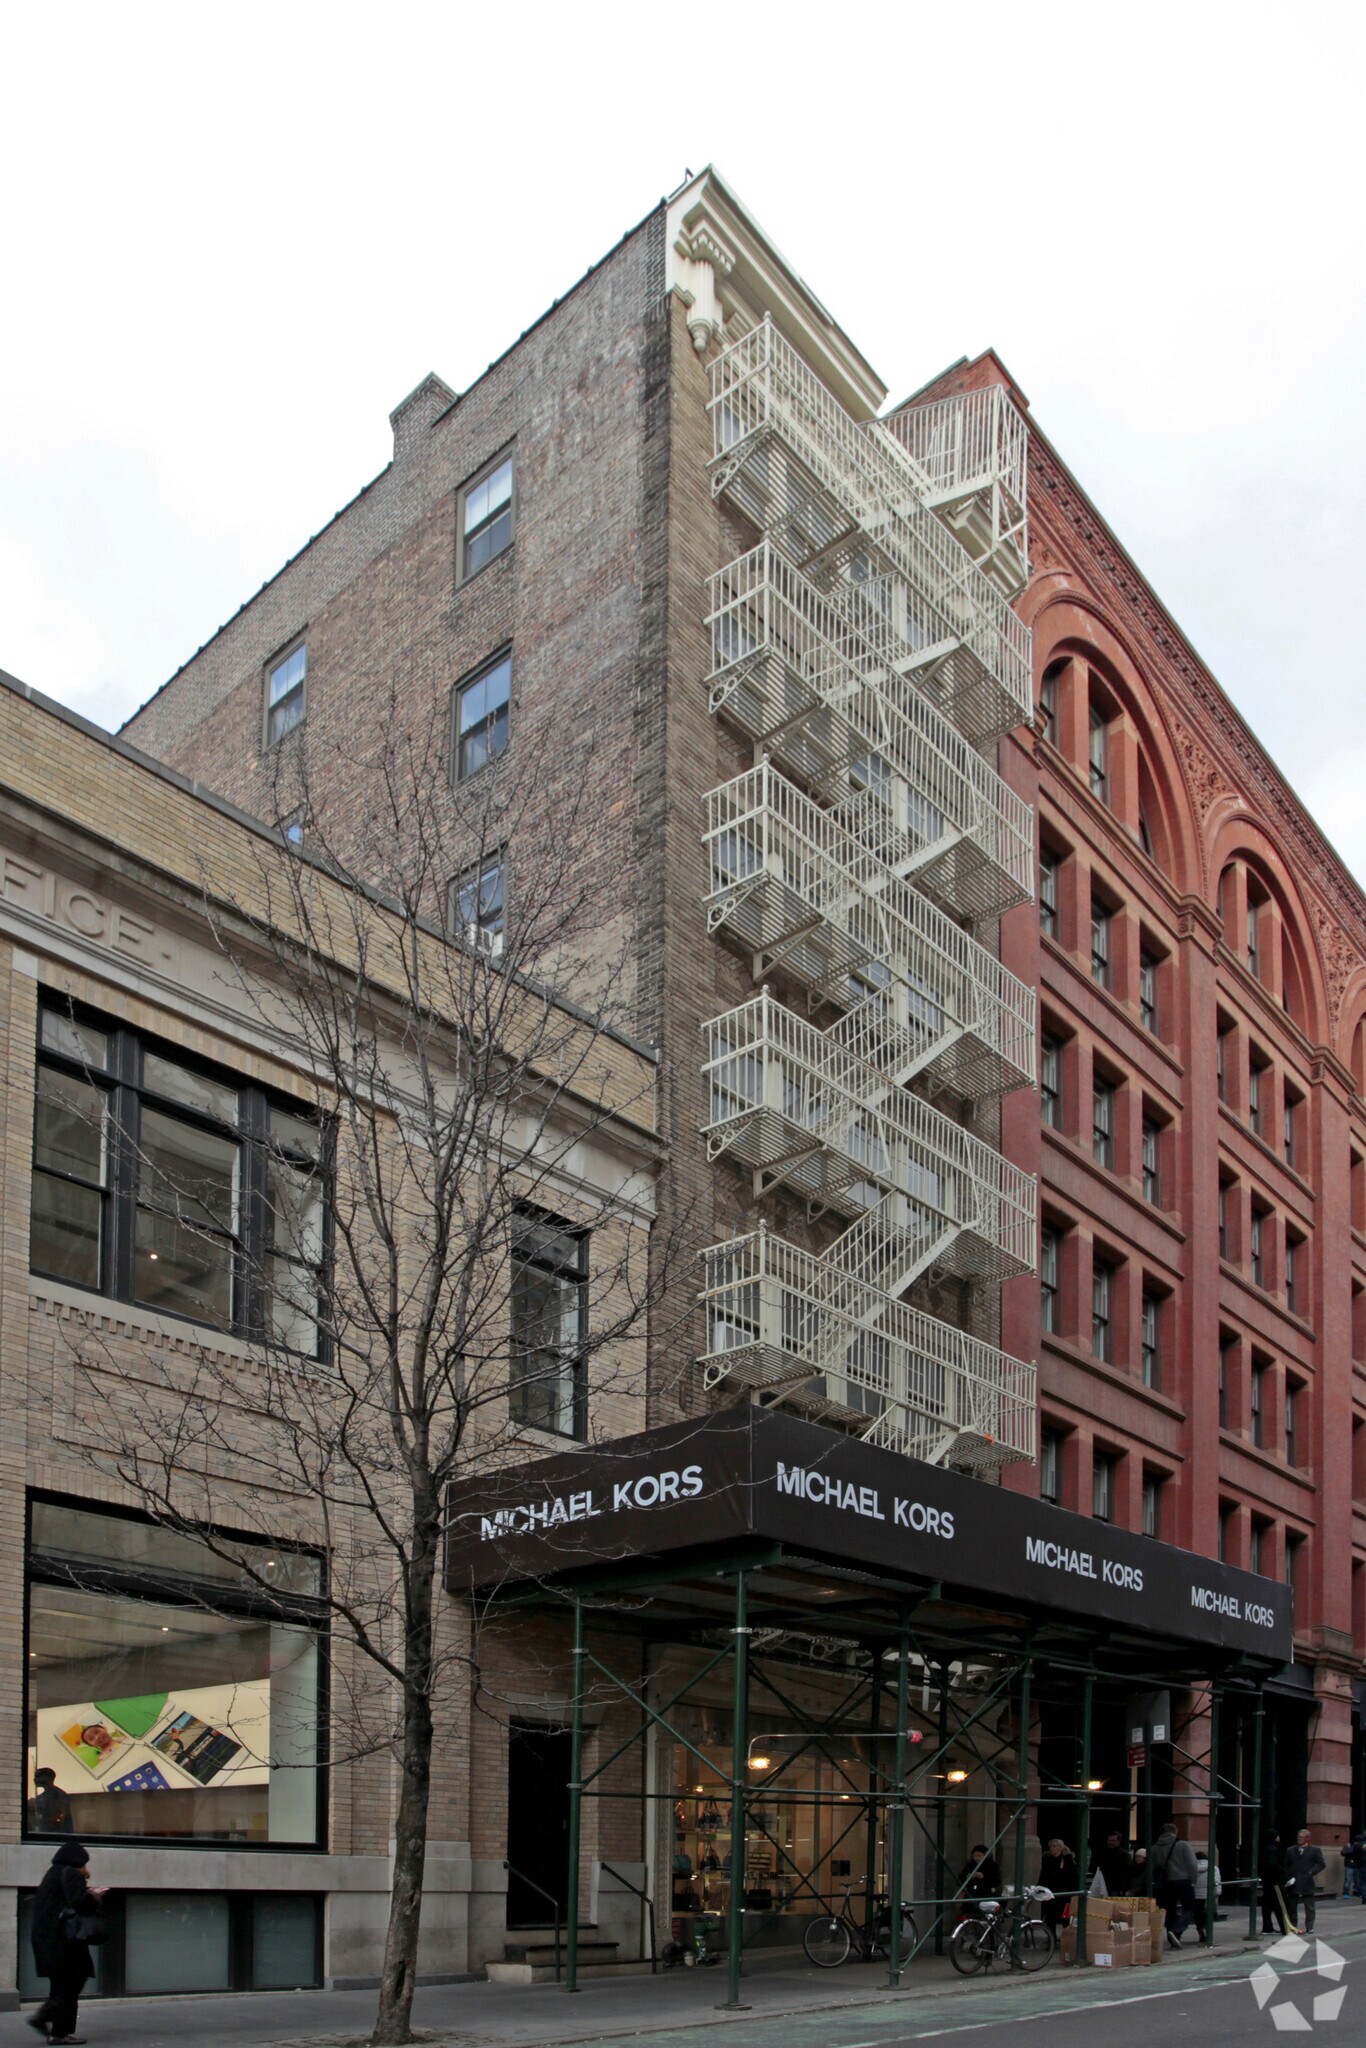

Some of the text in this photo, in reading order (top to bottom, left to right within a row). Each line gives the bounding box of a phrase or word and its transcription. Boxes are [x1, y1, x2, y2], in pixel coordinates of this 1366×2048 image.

[480, 1464, 704, 1541] MICHAEL KORS
[777, 1461, 955, 1539] MICHAEL KORS
[1026, 1536, 1144, 1592] MICHAEL KORS
[1191, 1585, 1275, 1628] MICHAEL KORS
